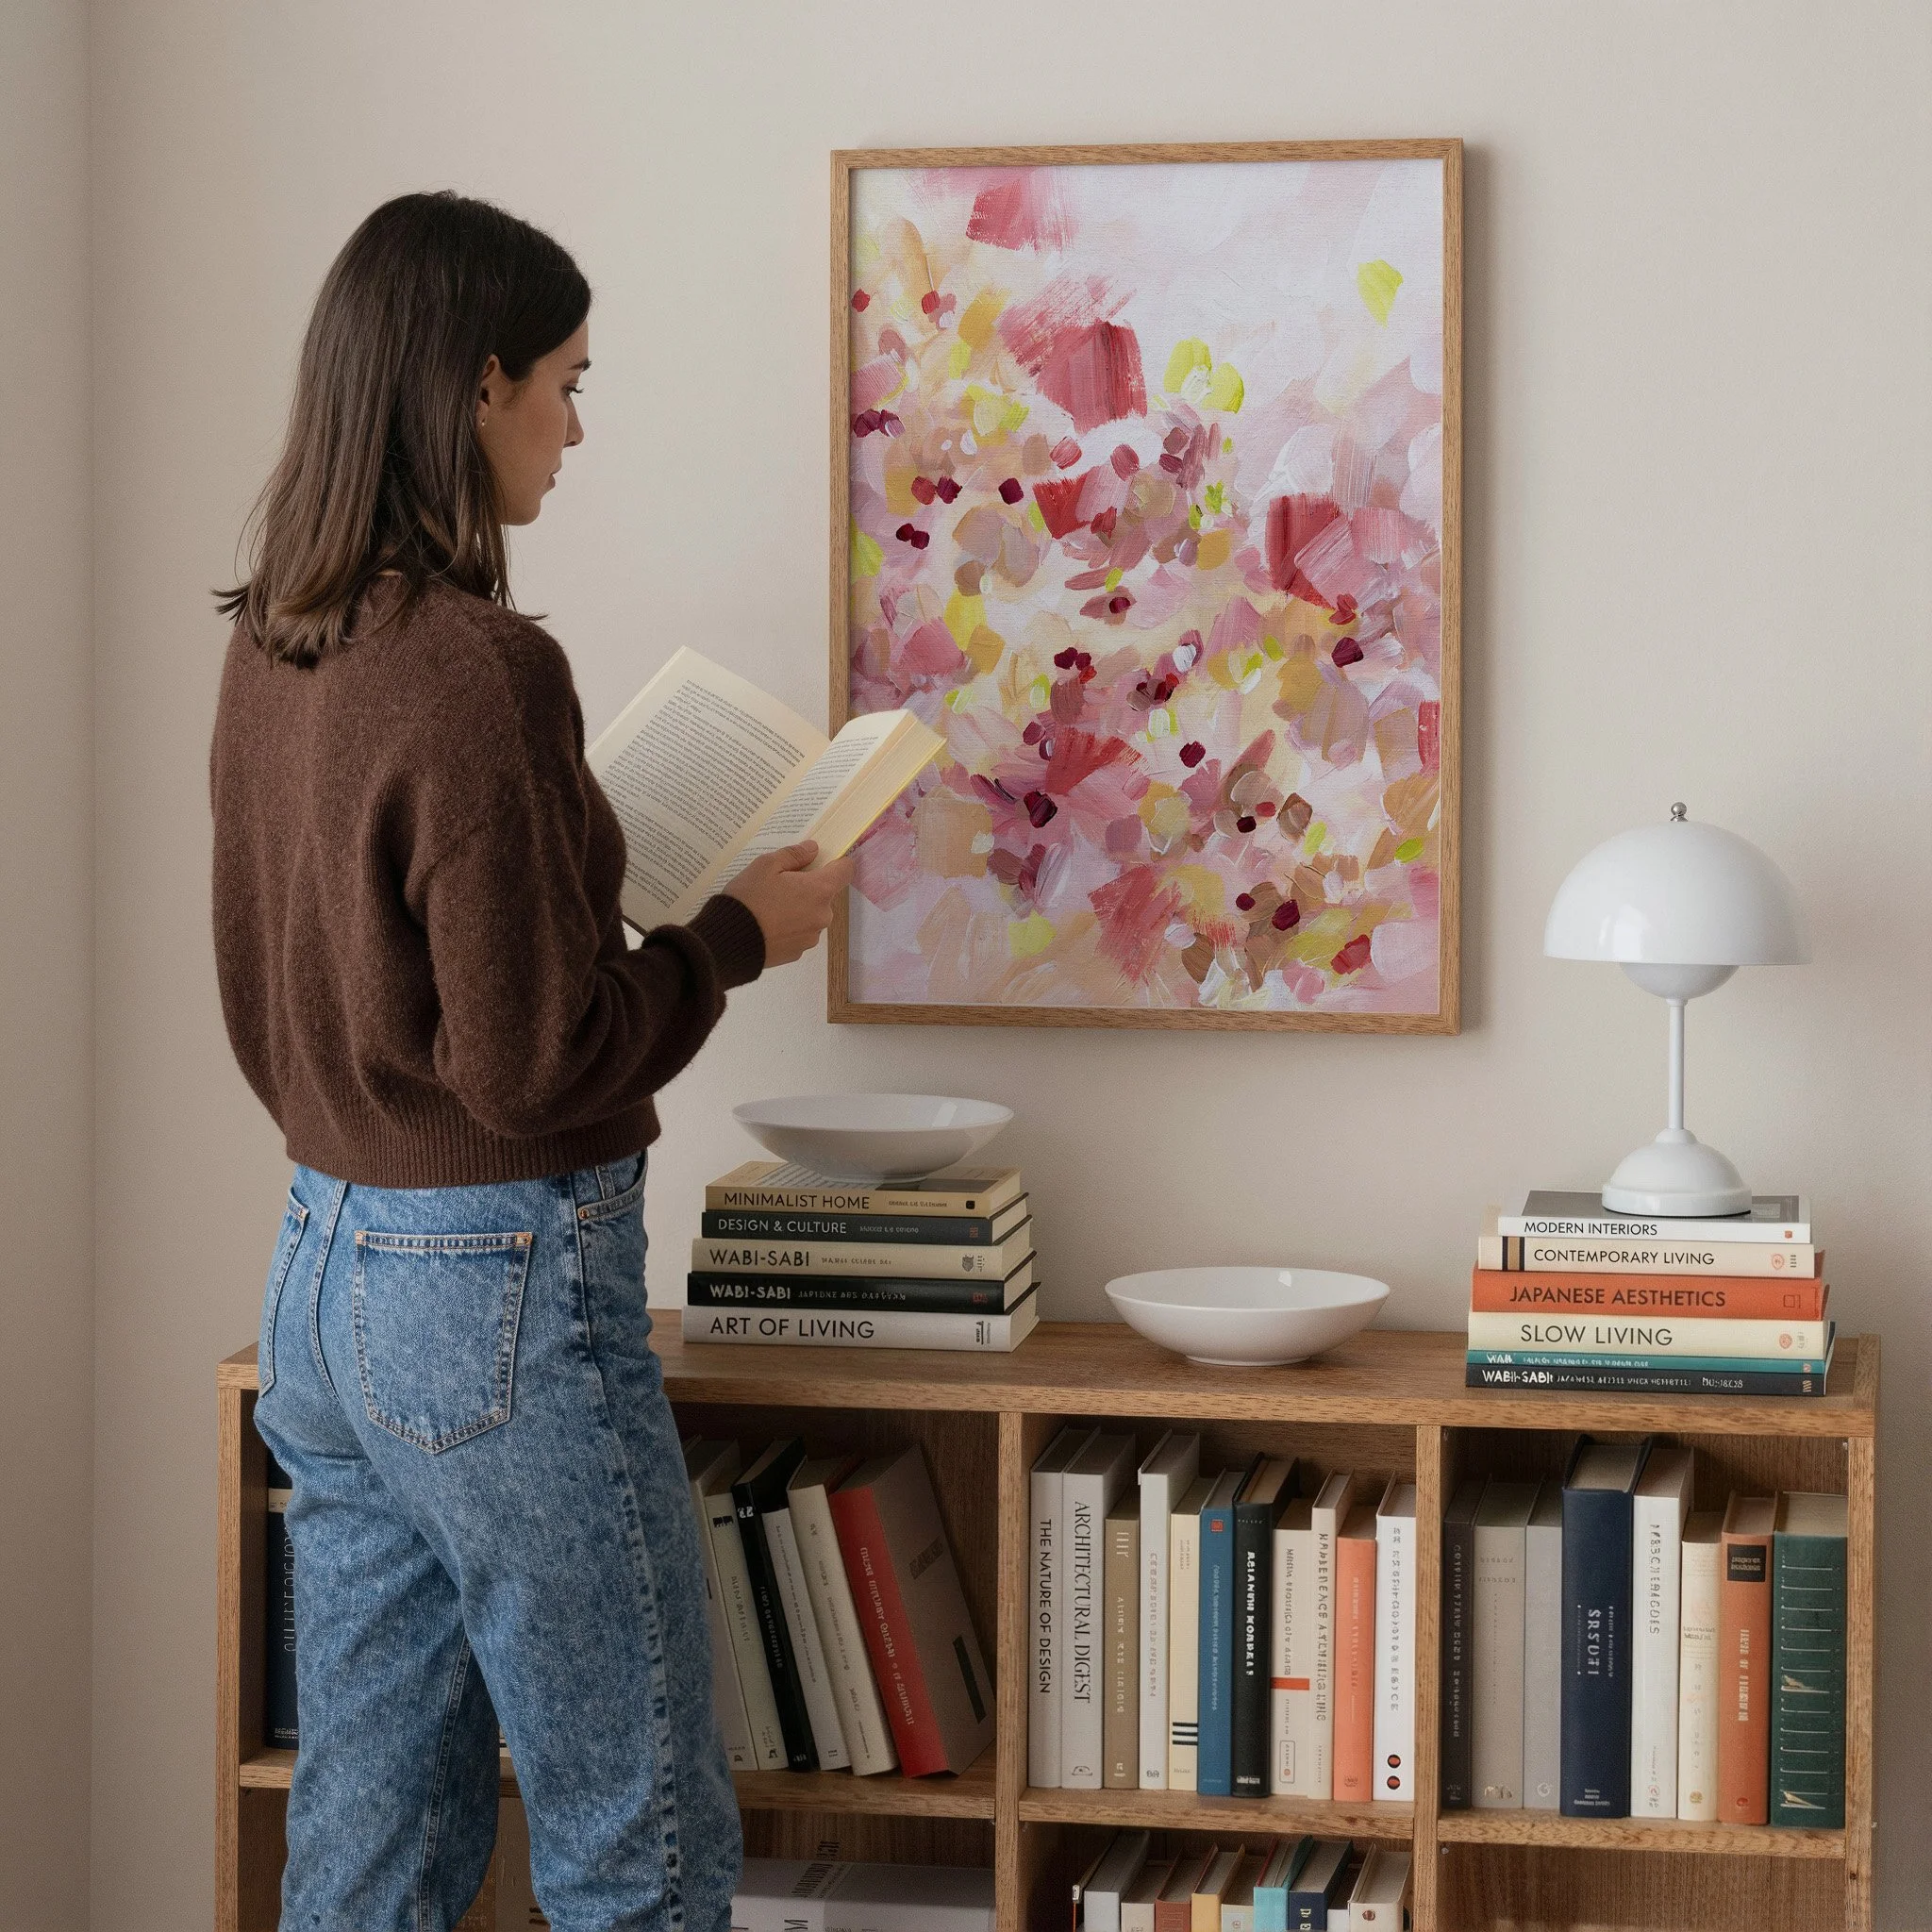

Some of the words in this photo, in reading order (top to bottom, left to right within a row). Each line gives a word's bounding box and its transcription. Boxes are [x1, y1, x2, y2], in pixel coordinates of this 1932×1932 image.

[724, 1191, 818, 1208] MINIMALIST
[823, 1195, 870, 1209] HOME
[718, 1218, 769, 1232] DESIGN
[774, 1220, 783, 1232] &
[787, 1221, 847, 1234] CULTURE
[1524, 1221, 1584, 1235] MODERN
[1588, 1223, 1657, 1236] INTERIORS
[709, 1248, 809, 1267] WABI-SABI
[1534, 1248, 1658, 1264] CONTEMPORARY
[1663, 1252, 1715, 1265] LIVING
[709, 1283, 791, 1300] WABI-SABI
[1509, 1286, 1605, 1305] JAPANESE
[1611, 1289, 1726, 1307] AESTHETICS
[709, 1316, 751, 1335] ART
[758, 1318, 790, 1336] OF
[798, 1319, 874, 1339] LIVING
[1521, 1324, 1586, 1343] SLOW
[1595, 1326, 1673, 1346] LIVING
[1039, 1518, 1052, 1547] THE
[1039, 1551, 1052, 1608] NATURE
[1074, 1501, 1091, 1641] ARCHITECTURAL
[1039, 1612, 1052, 1634] OF
[1039, 1638, 1052, 1693] DESIGN
[1074, 1644, 1091, 1704] DIGEST
